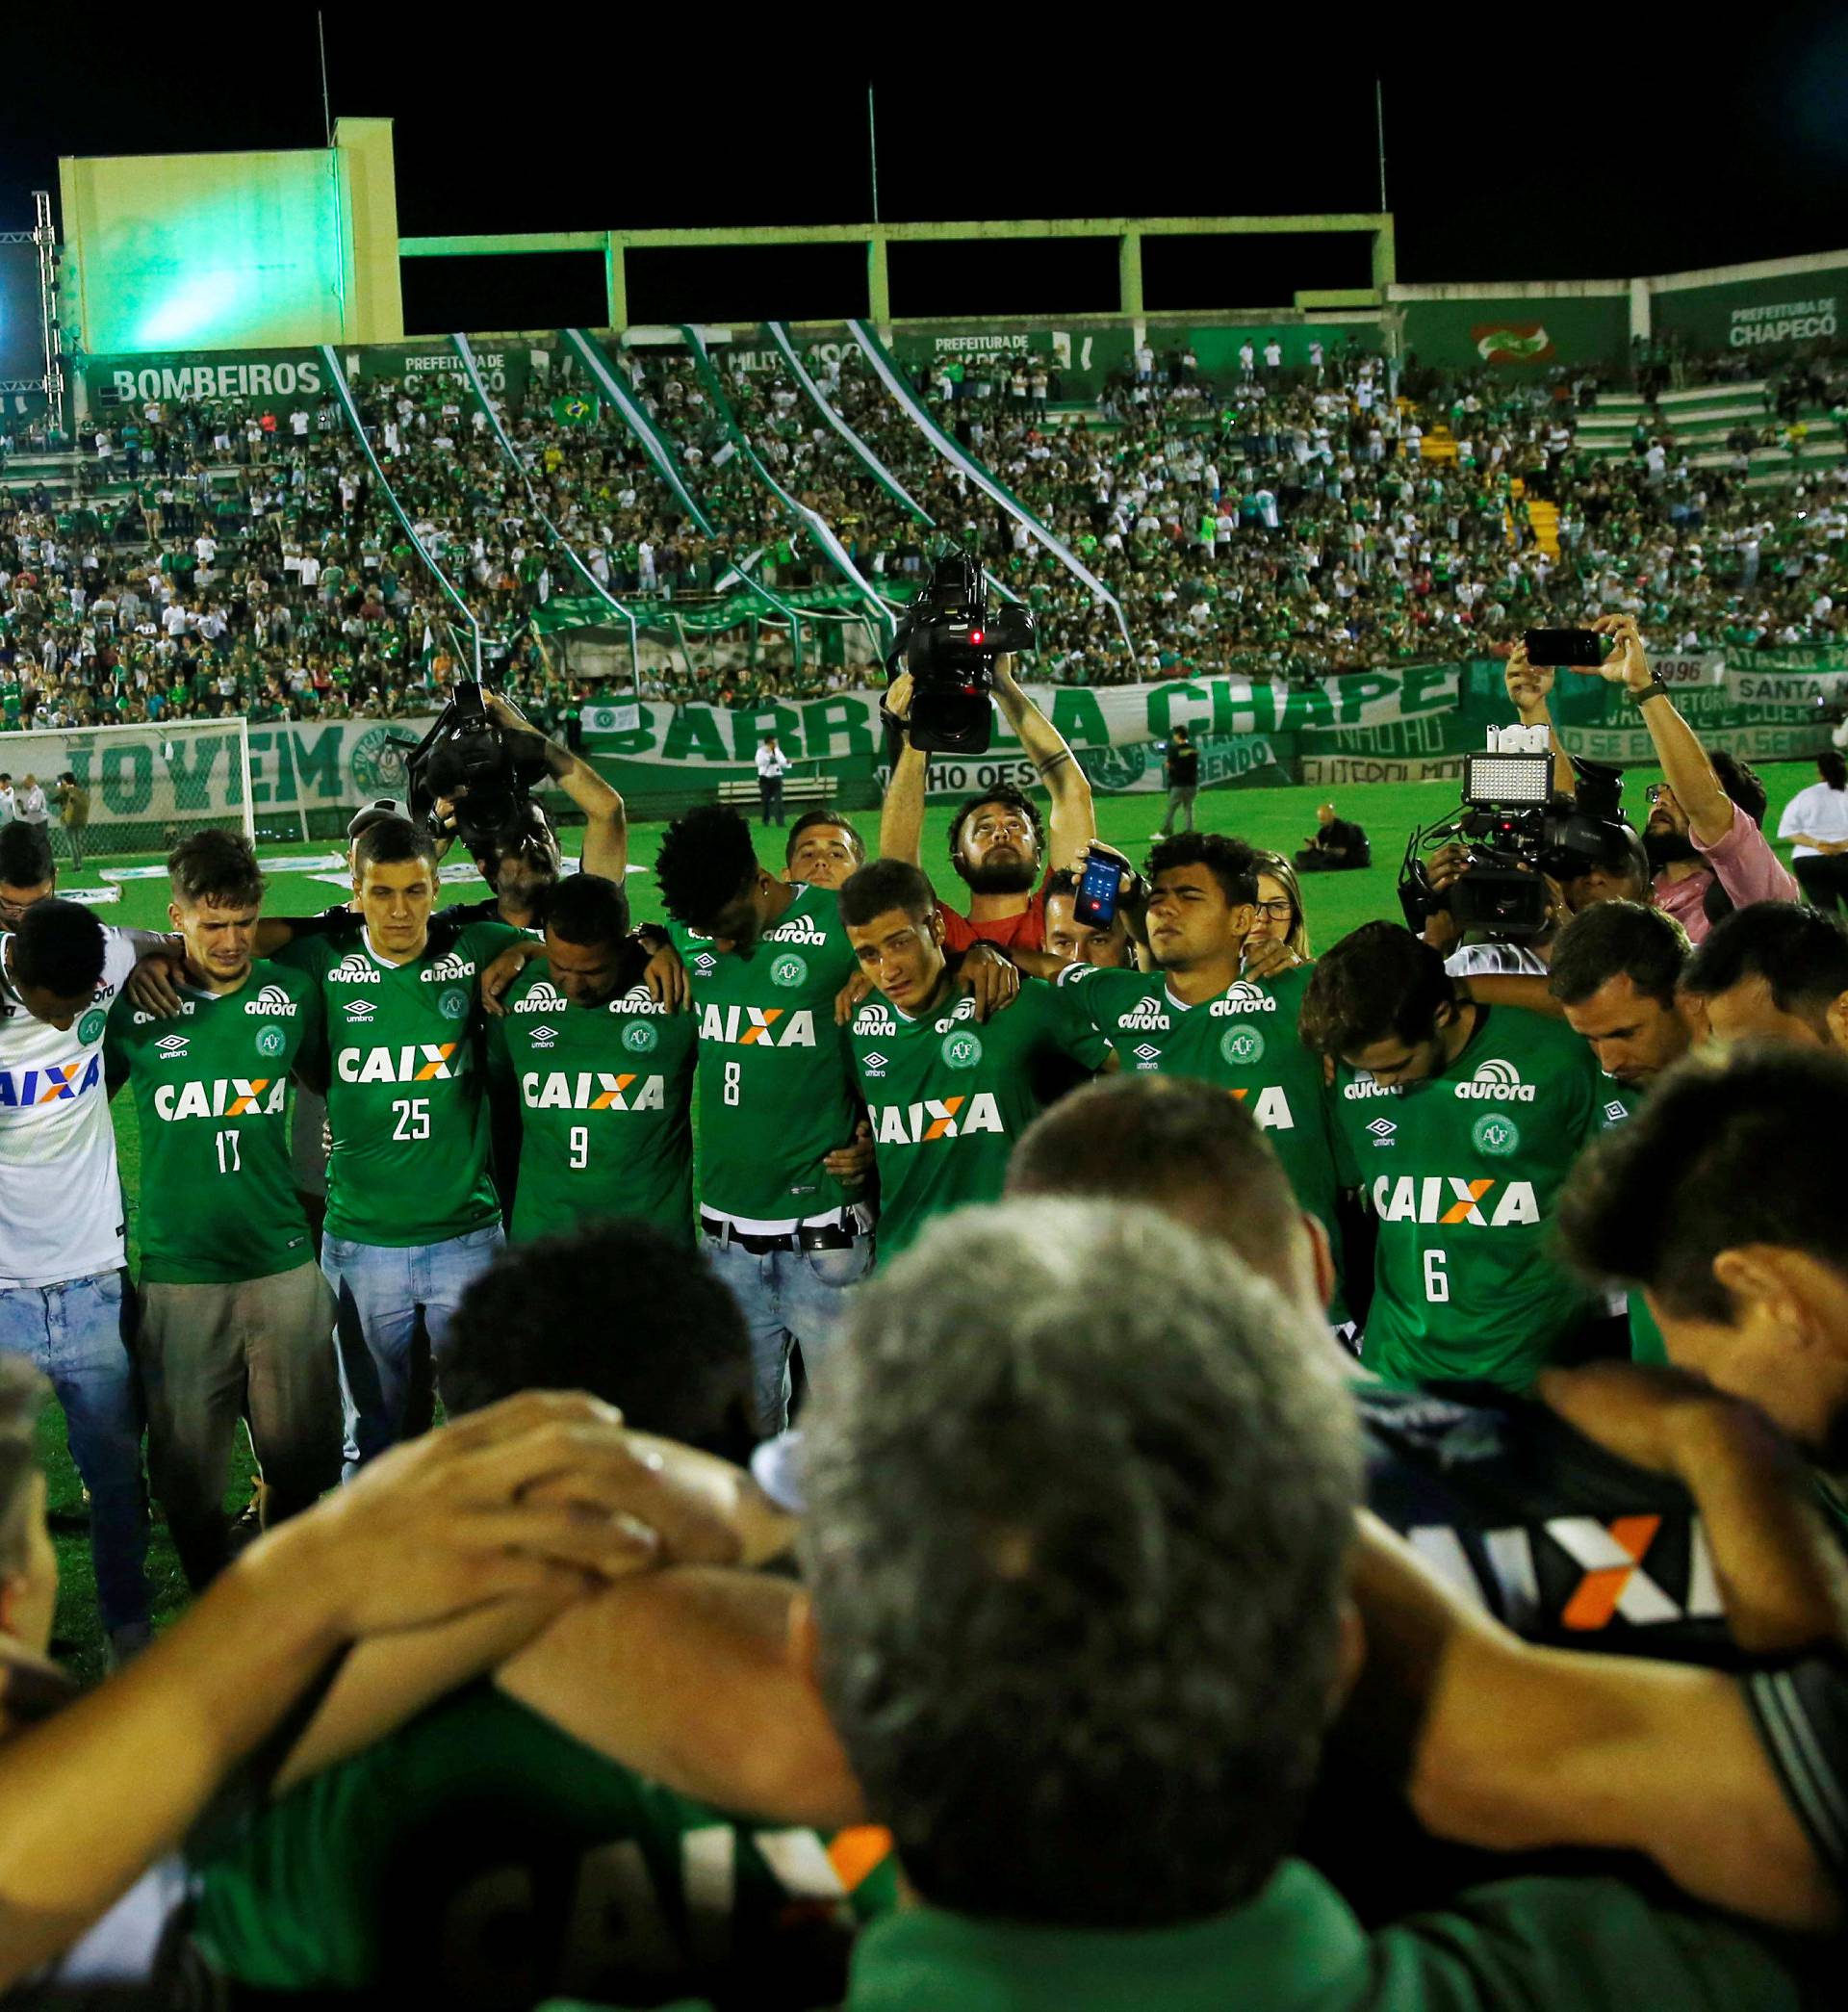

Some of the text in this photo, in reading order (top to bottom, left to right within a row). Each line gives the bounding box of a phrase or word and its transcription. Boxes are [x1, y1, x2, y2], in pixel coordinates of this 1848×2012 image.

[1732, 297, 1835, 323] PREFEITURA DE
[1730, 315, 1836, 348] CHAPECÓ
[935, 335, 1029, 352] PREFEITURA DE
[486, 354, 504, 368] DE
[113, 362, 321, 401] BOMBEIROS
[1738, 678, 1822, 700] SANTA
[1146, 663, 1460, 740] CHAPE
[762, 927, 827, 947] aurora
[328, 967, 381, 984] aurora
[420, 961, 475, 983] aurora
[244, 1000, 297, 1017] aurora
[514, 997, 568, 1014] aurora
[1209, 995, 1277, 1018] aurora
[1117, 1012, 1170, 1030] aurora
[159, 1049, 188, 1060] umbro
[723, 1061, 741, 1107] 8
[864, 1069, 886, 1077] umbro
[154, 1077, 287, 1122] CAIXA
[523, 1072, 665, 1111] CAIXA
[1454, 1081, 1536, 1102] aurora
[392, 1097, 431, 1141] 25
[215, 1129, 241, 1174] 17
[570, 1126, 588, 1169] 9
[1373, 1174, 1541, 1227] CAIXA
[1423, 1249, 1450, 1303] 6
